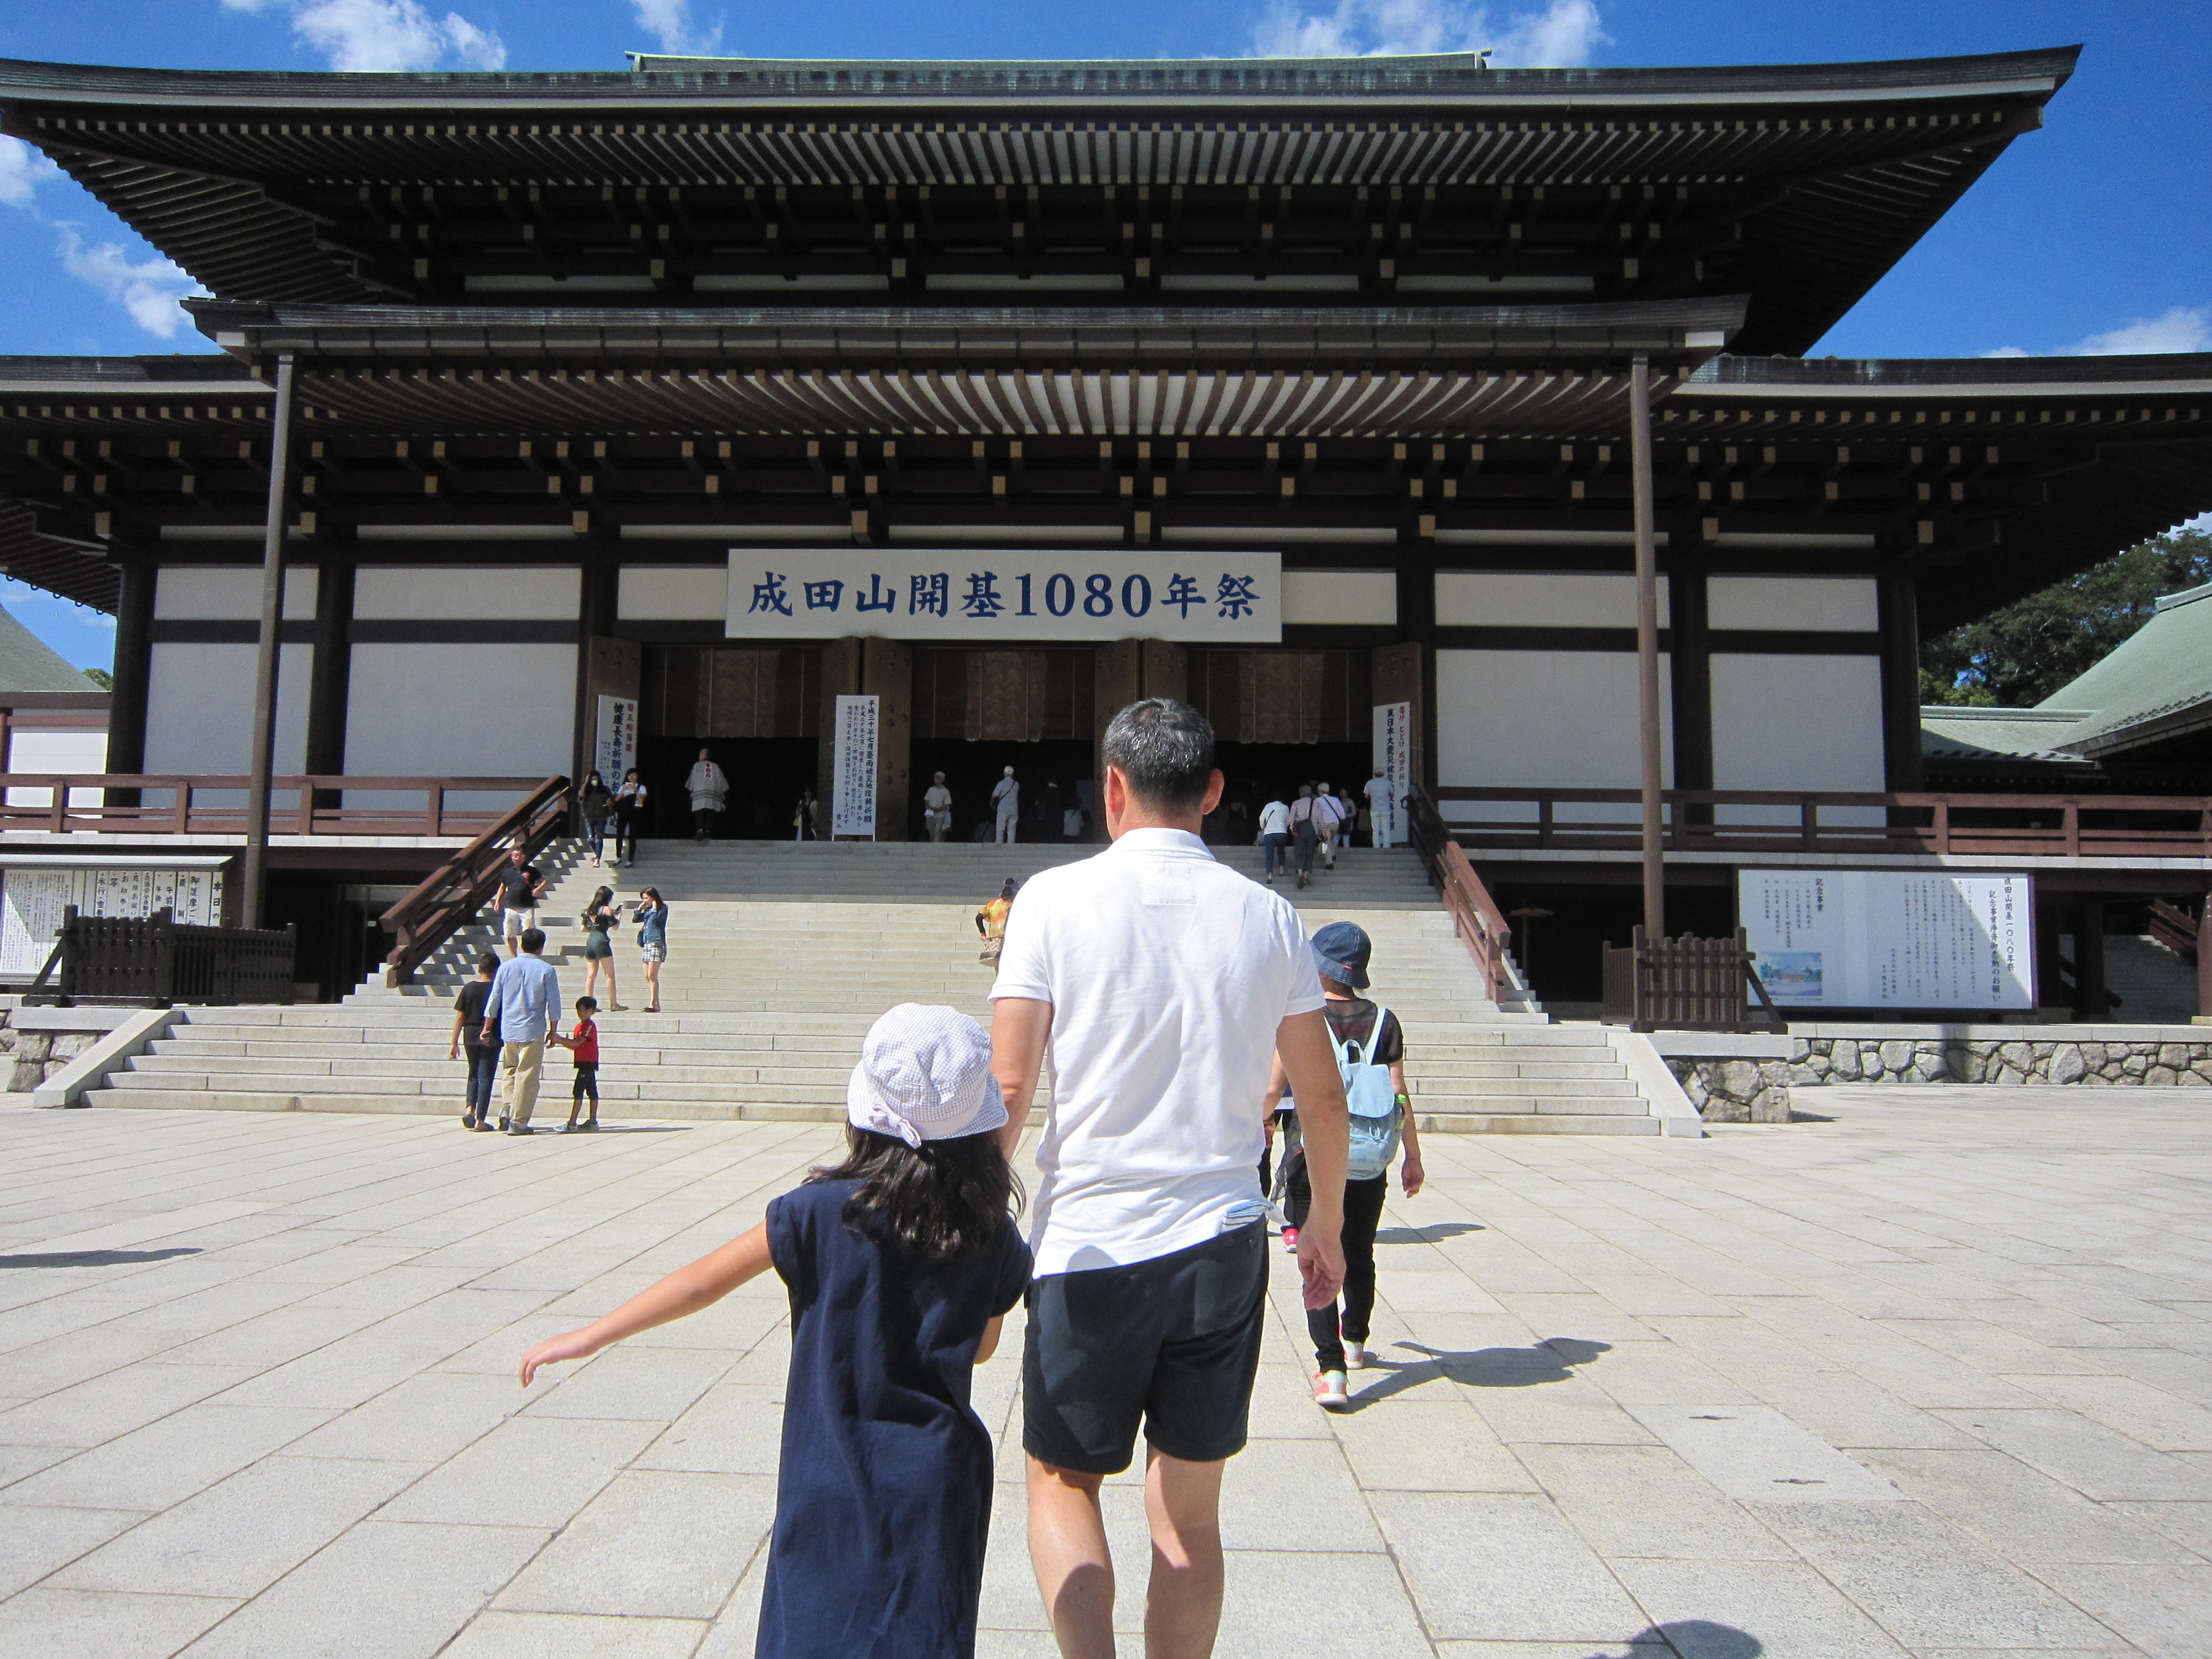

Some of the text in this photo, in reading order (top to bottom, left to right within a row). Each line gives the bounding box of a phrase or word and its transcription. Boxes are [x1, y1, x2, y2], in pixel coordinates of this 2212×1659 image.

[747, 571, 1261, 620] 成田山開基1080年祭
